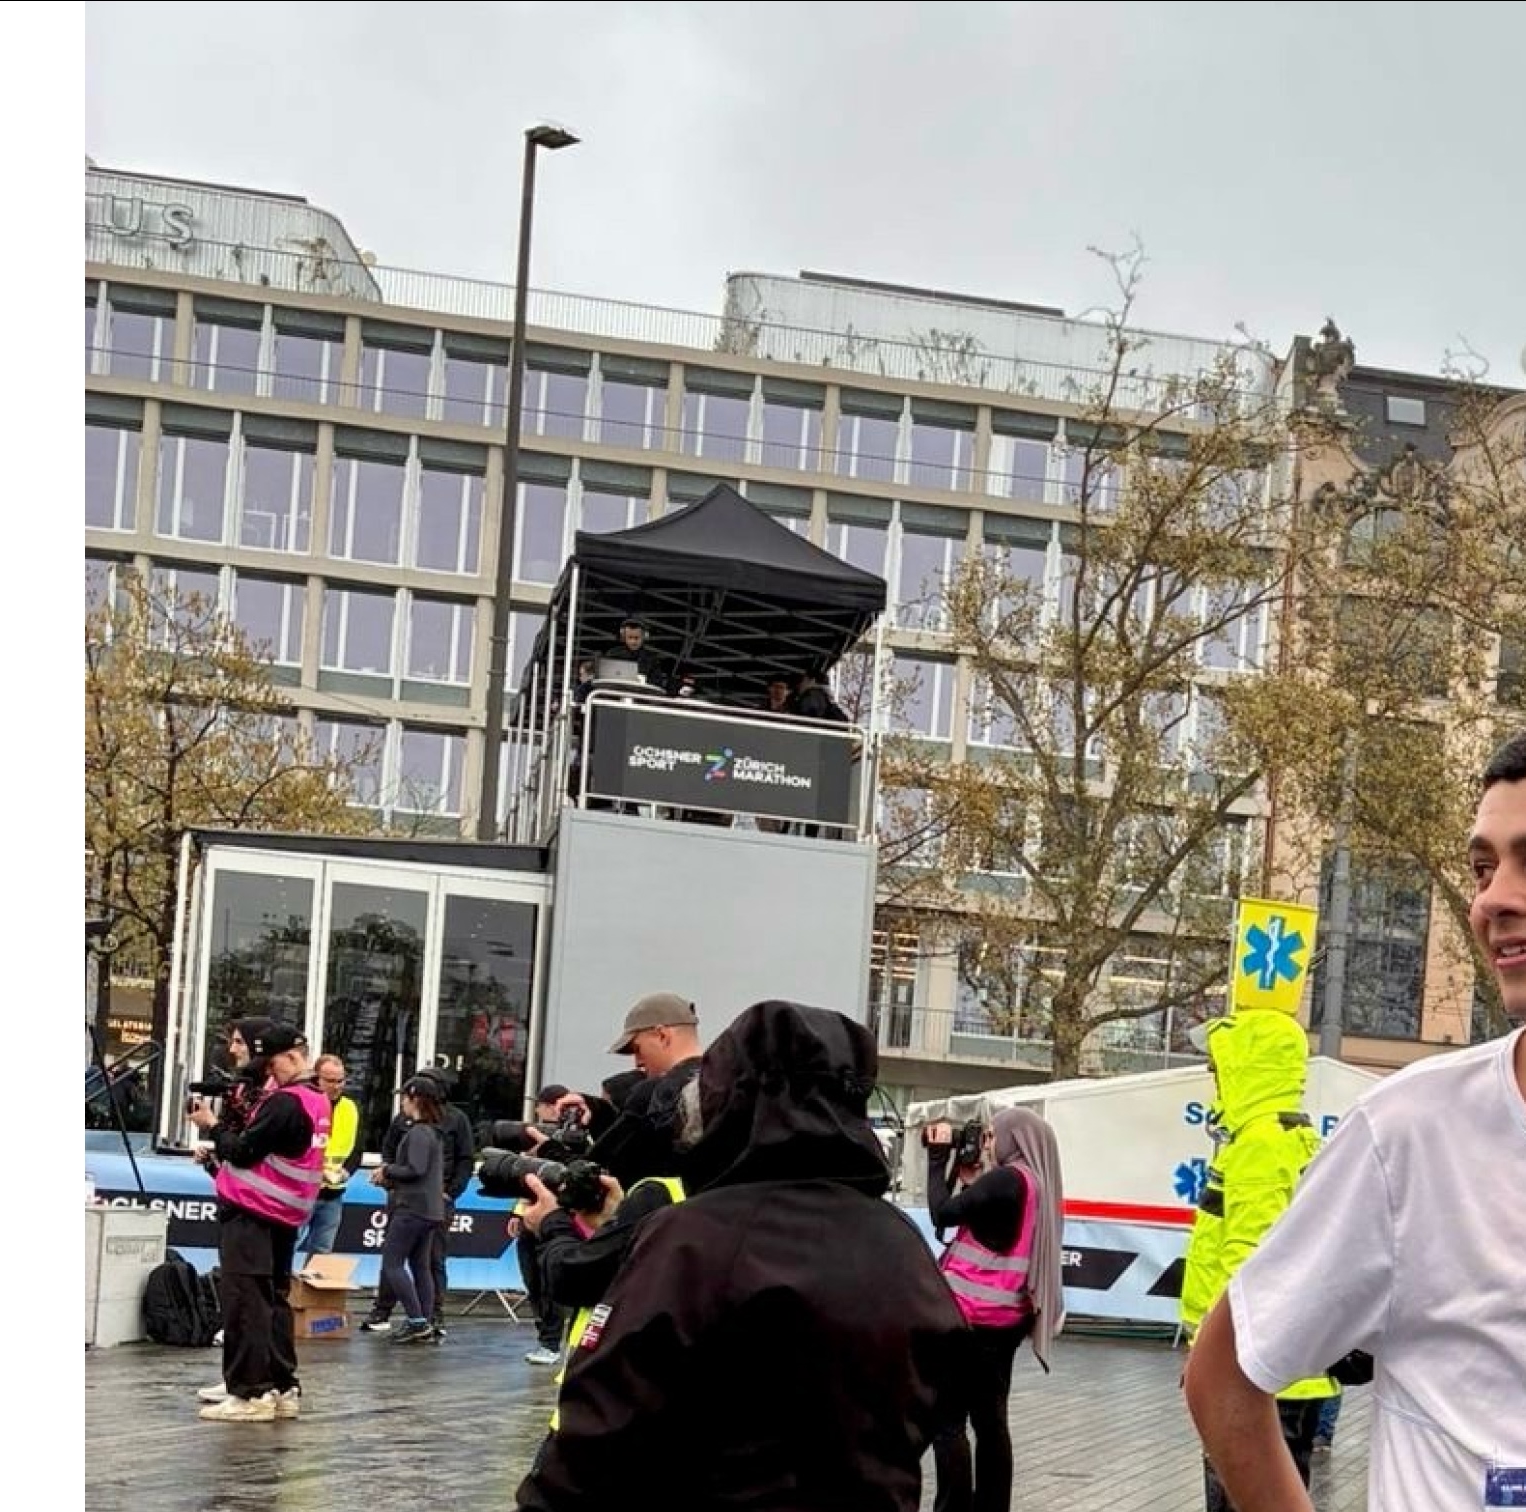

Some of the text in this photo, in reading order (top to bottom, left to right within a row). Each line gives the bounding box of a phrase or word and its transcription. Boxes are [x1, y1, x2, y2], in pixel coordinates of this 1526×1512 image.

[628, 755, 676, 772] SPORT
[632, 744, 702, 765] OCHSNER
[733, 755, 786, 774] ZÜRICH
[733, 769, 813, 789] MARATHON
